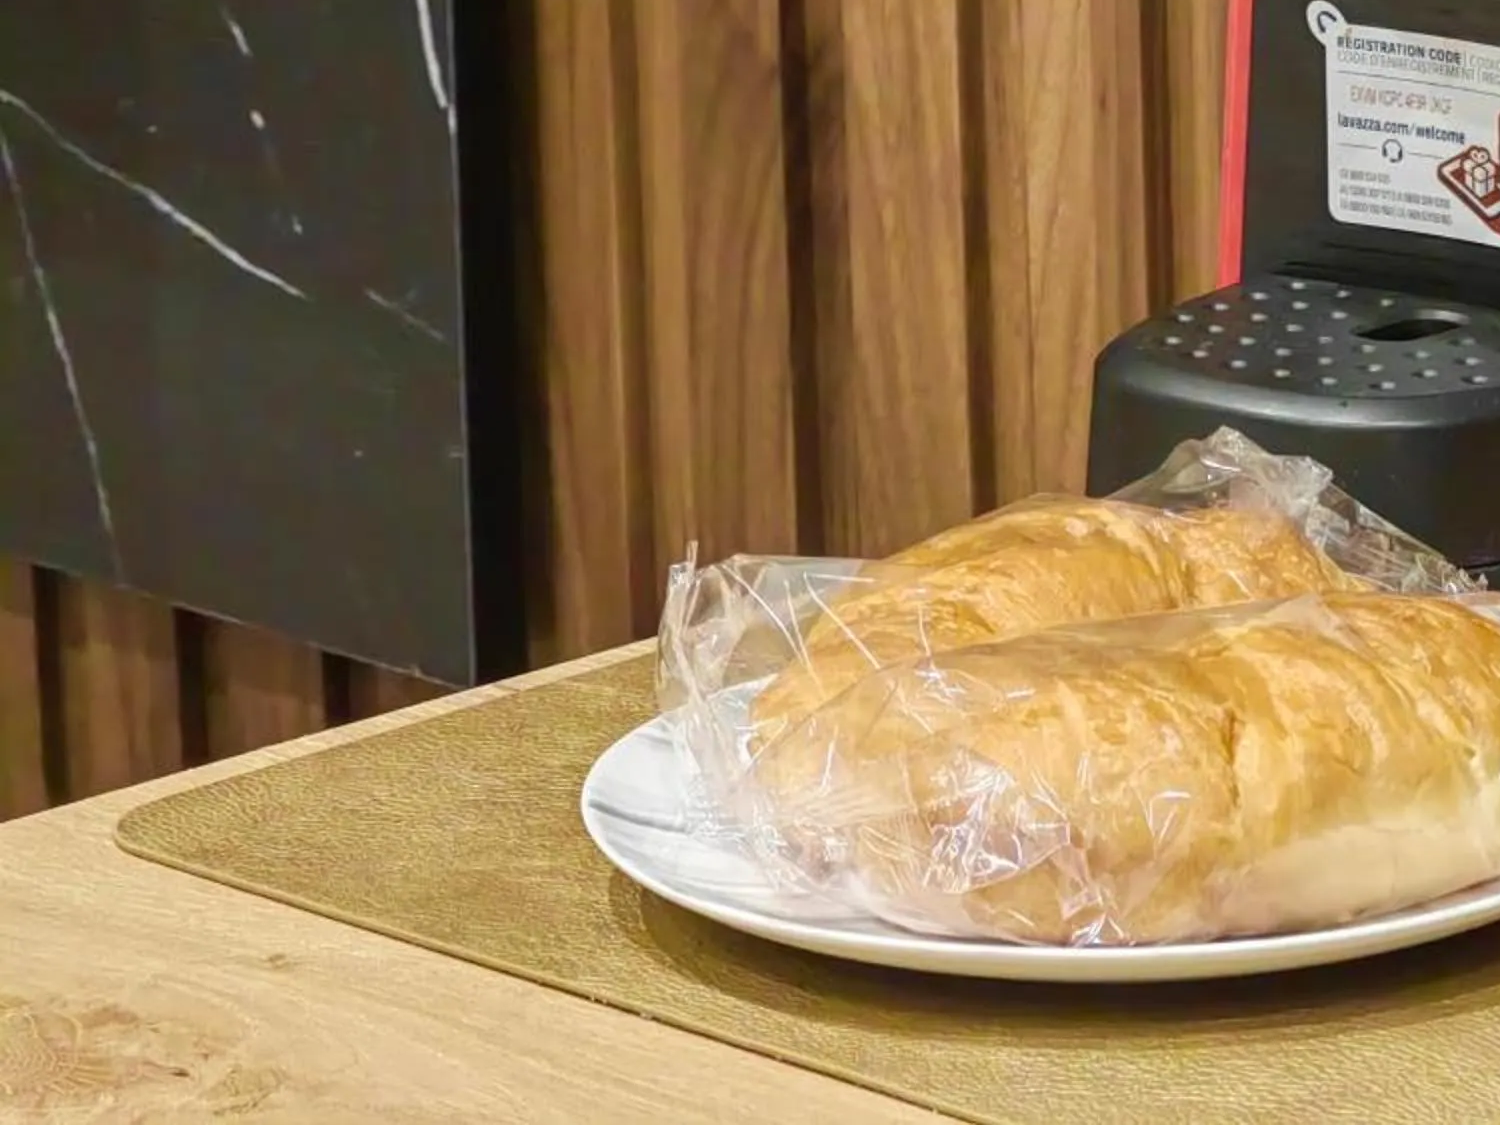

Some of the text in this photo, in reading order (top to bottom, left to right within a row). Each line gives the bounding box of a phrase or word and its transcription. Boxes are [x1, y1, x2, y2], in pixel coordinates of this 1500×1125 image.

[1337, 35, 1425, 58] REGISTRATION
[1428, 47, 1462, 65] CODE
[1337, 111, 1465, 145] lavazza.com/welcome
